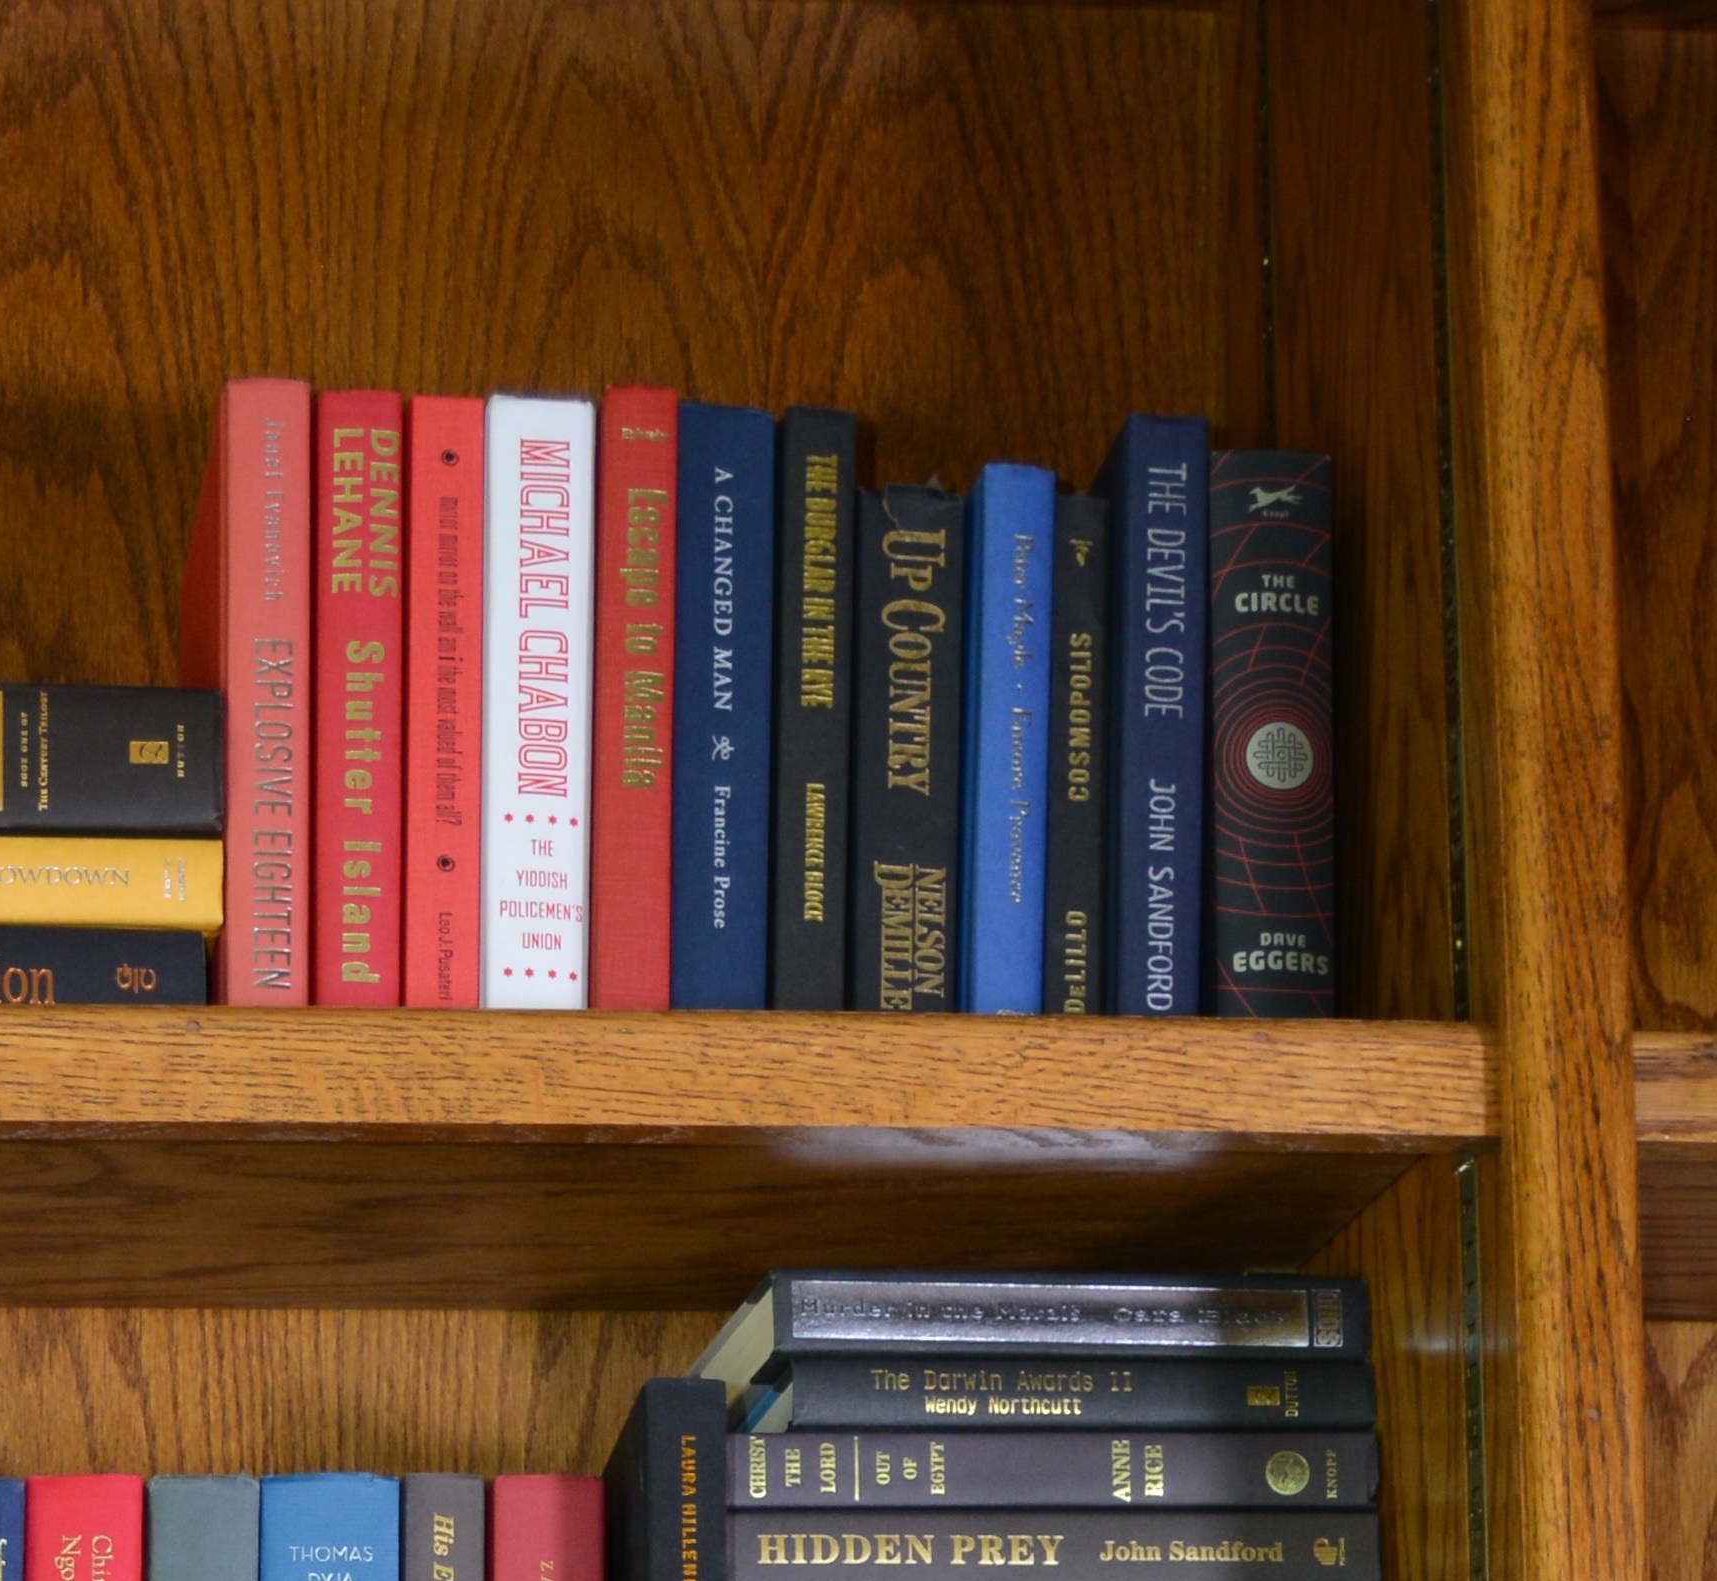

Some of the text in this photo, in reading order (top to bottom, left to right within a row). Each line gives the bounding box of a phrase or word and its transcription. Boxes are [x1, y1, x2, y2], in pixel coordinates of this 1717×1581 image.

[332, 428, 364, 593] LEHANE
[369, 429, 399, 596] DENNIS
[1262, 574, 1293, 588] THE
[1234, 591, 1320, 616] CIRCLE
[518, 438, 570, 797] MICHAEL CHABON
[713, 467, 734, 929] A CHANGED MAN Francine Prose
[1068, 633, 1091, 801] COSMOPOLIS
[252, 637, 293, 990] EXPLOSIVE EIGHTEEN
[342, 640, 385, 983] Shutter Island
[531, 839, 553, 857] THE
[517, 870, 567, 888] YIDDISH
[499, 901, 584, 923] POLICEMEN'S
[523, 933, 561, 950] UNION
[1260, 932, 1306, 948] DAVE
[1232, 951, 1329, 976] EGGERS
[290, 1546, 373, 1562] THOMAS
[758, 1534, 1284, 1565] HIDDEN PREY John Sandford
